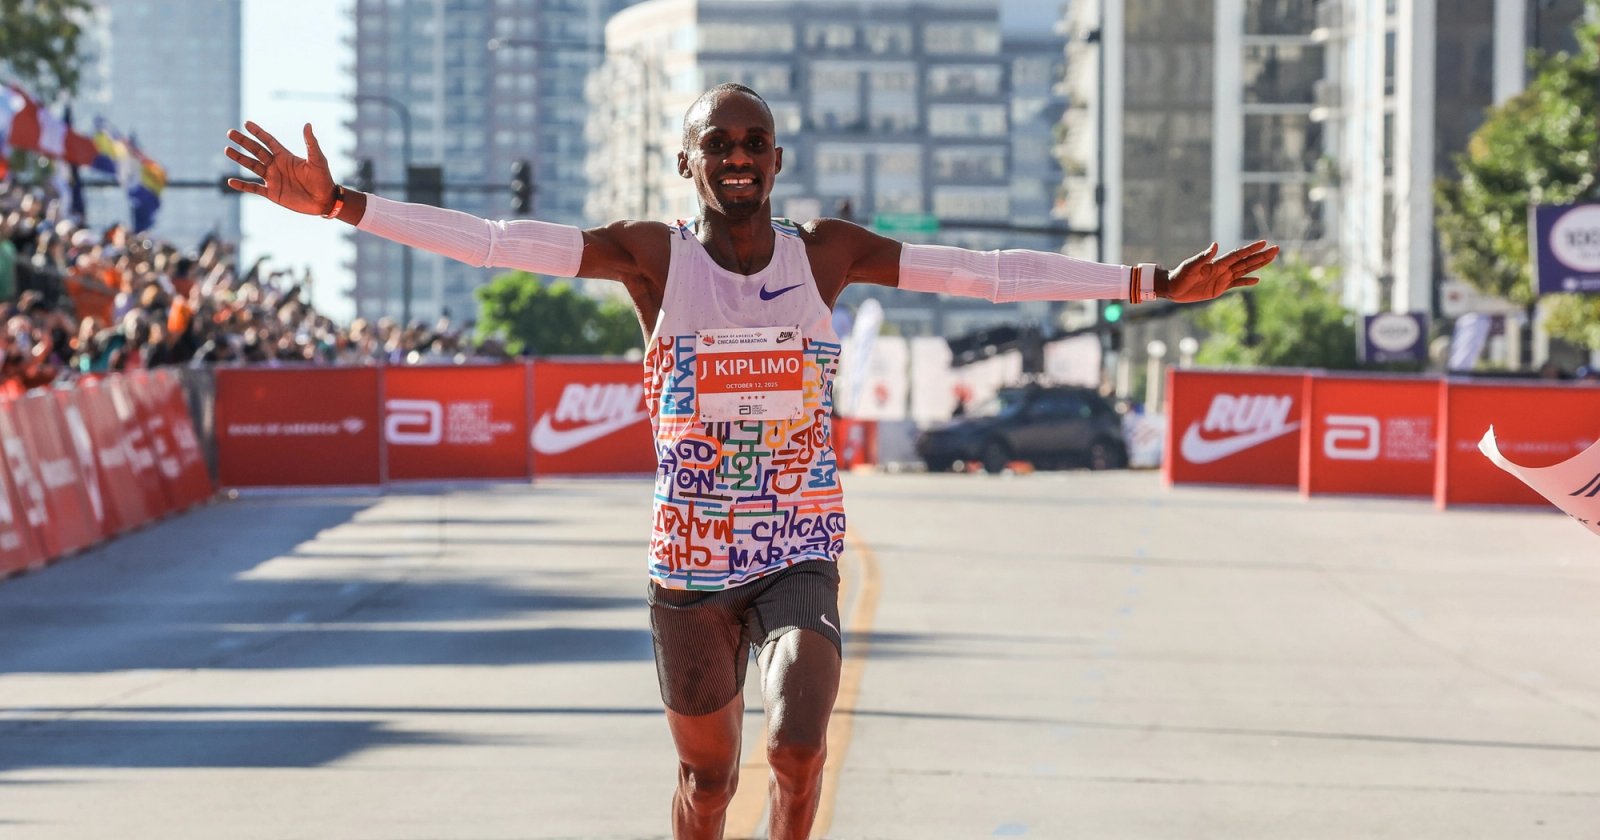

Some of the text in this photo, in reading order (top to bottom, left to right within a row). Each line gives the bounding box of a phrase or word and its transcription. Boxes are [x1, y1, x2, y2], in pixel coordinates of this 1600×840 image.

[700, 357, 800, 380] J KIPLIMO
[556, 383, 643, 422] RUN
[1204, 393, 1293, 432] RUN
[751, 506, 846, 542] CHICAGO
